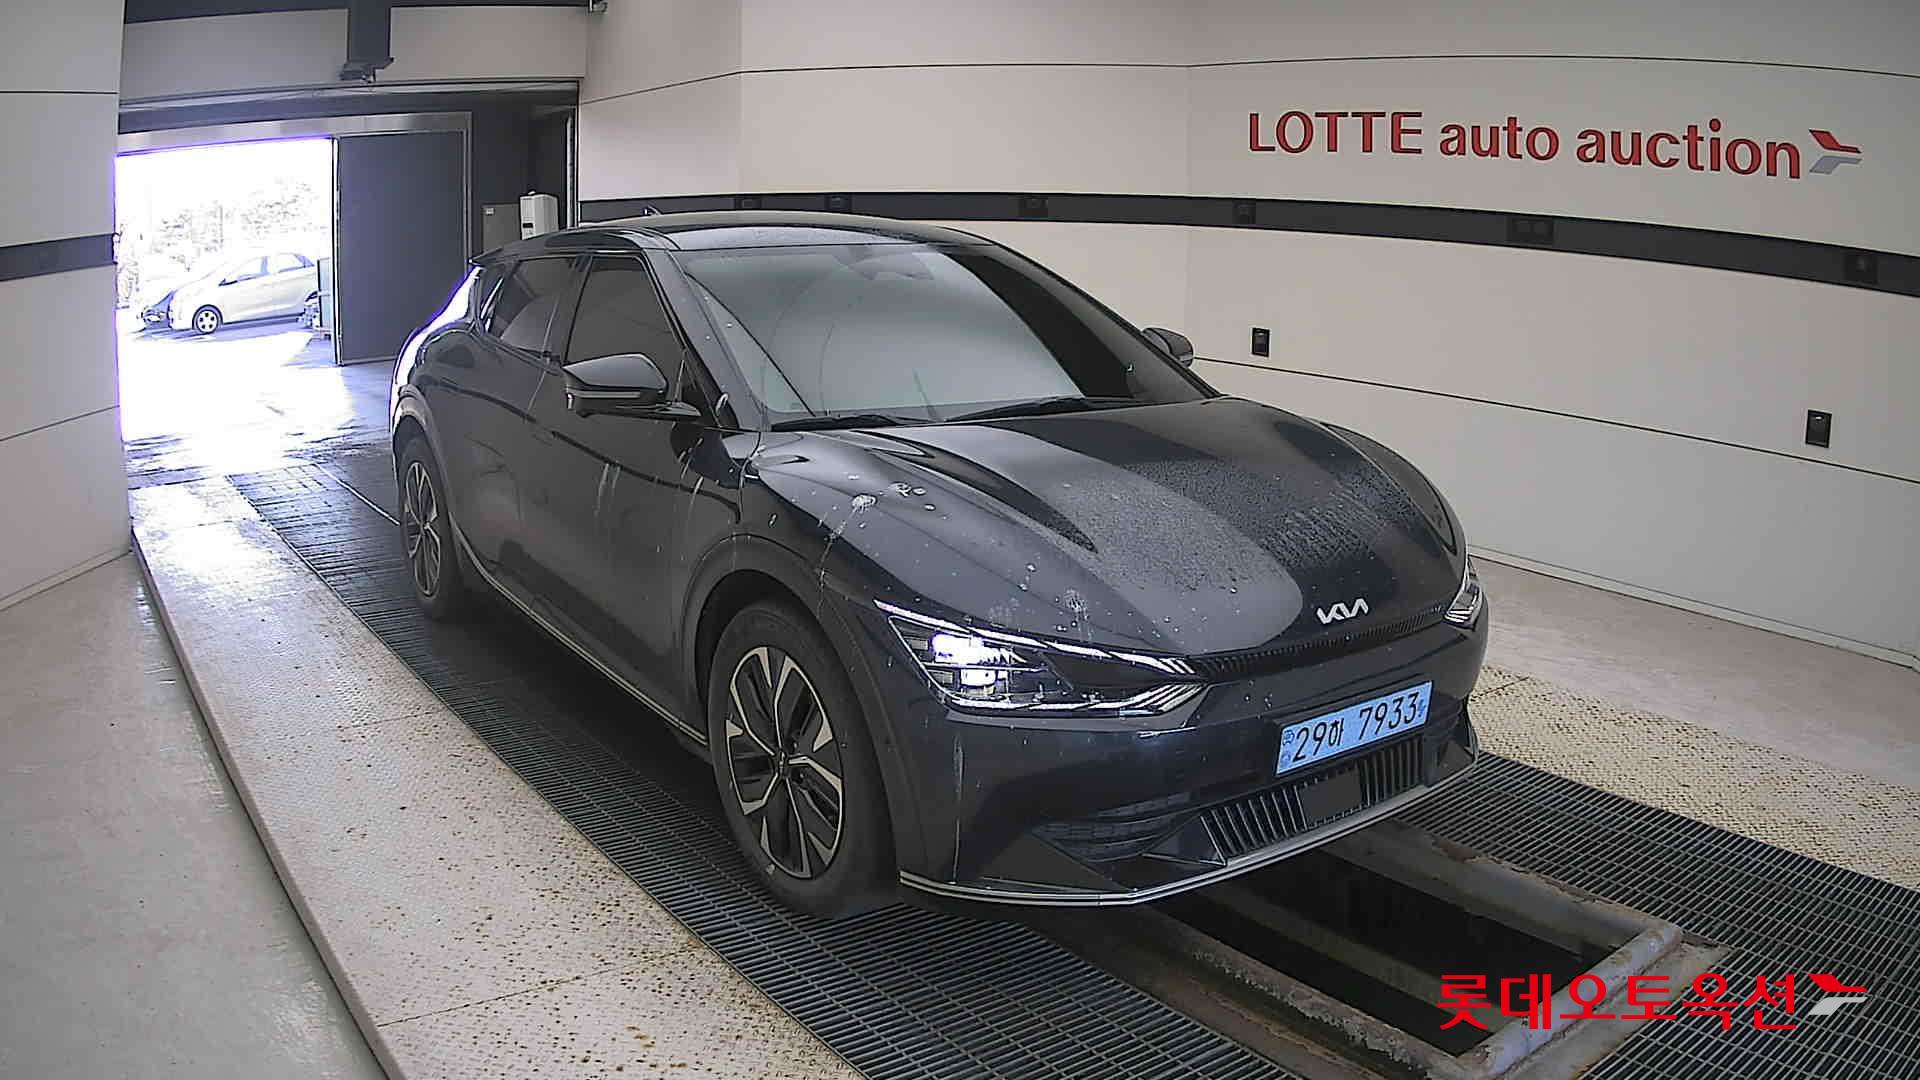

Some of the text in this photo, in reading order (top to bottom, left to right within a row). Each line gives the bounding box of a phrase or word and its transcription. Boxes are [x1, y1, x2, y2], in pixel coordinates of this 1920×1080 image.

[1249, 111, 1801, 179] LOTTE auto auction
[1293, 692, 1419, 762] 29하 7933
